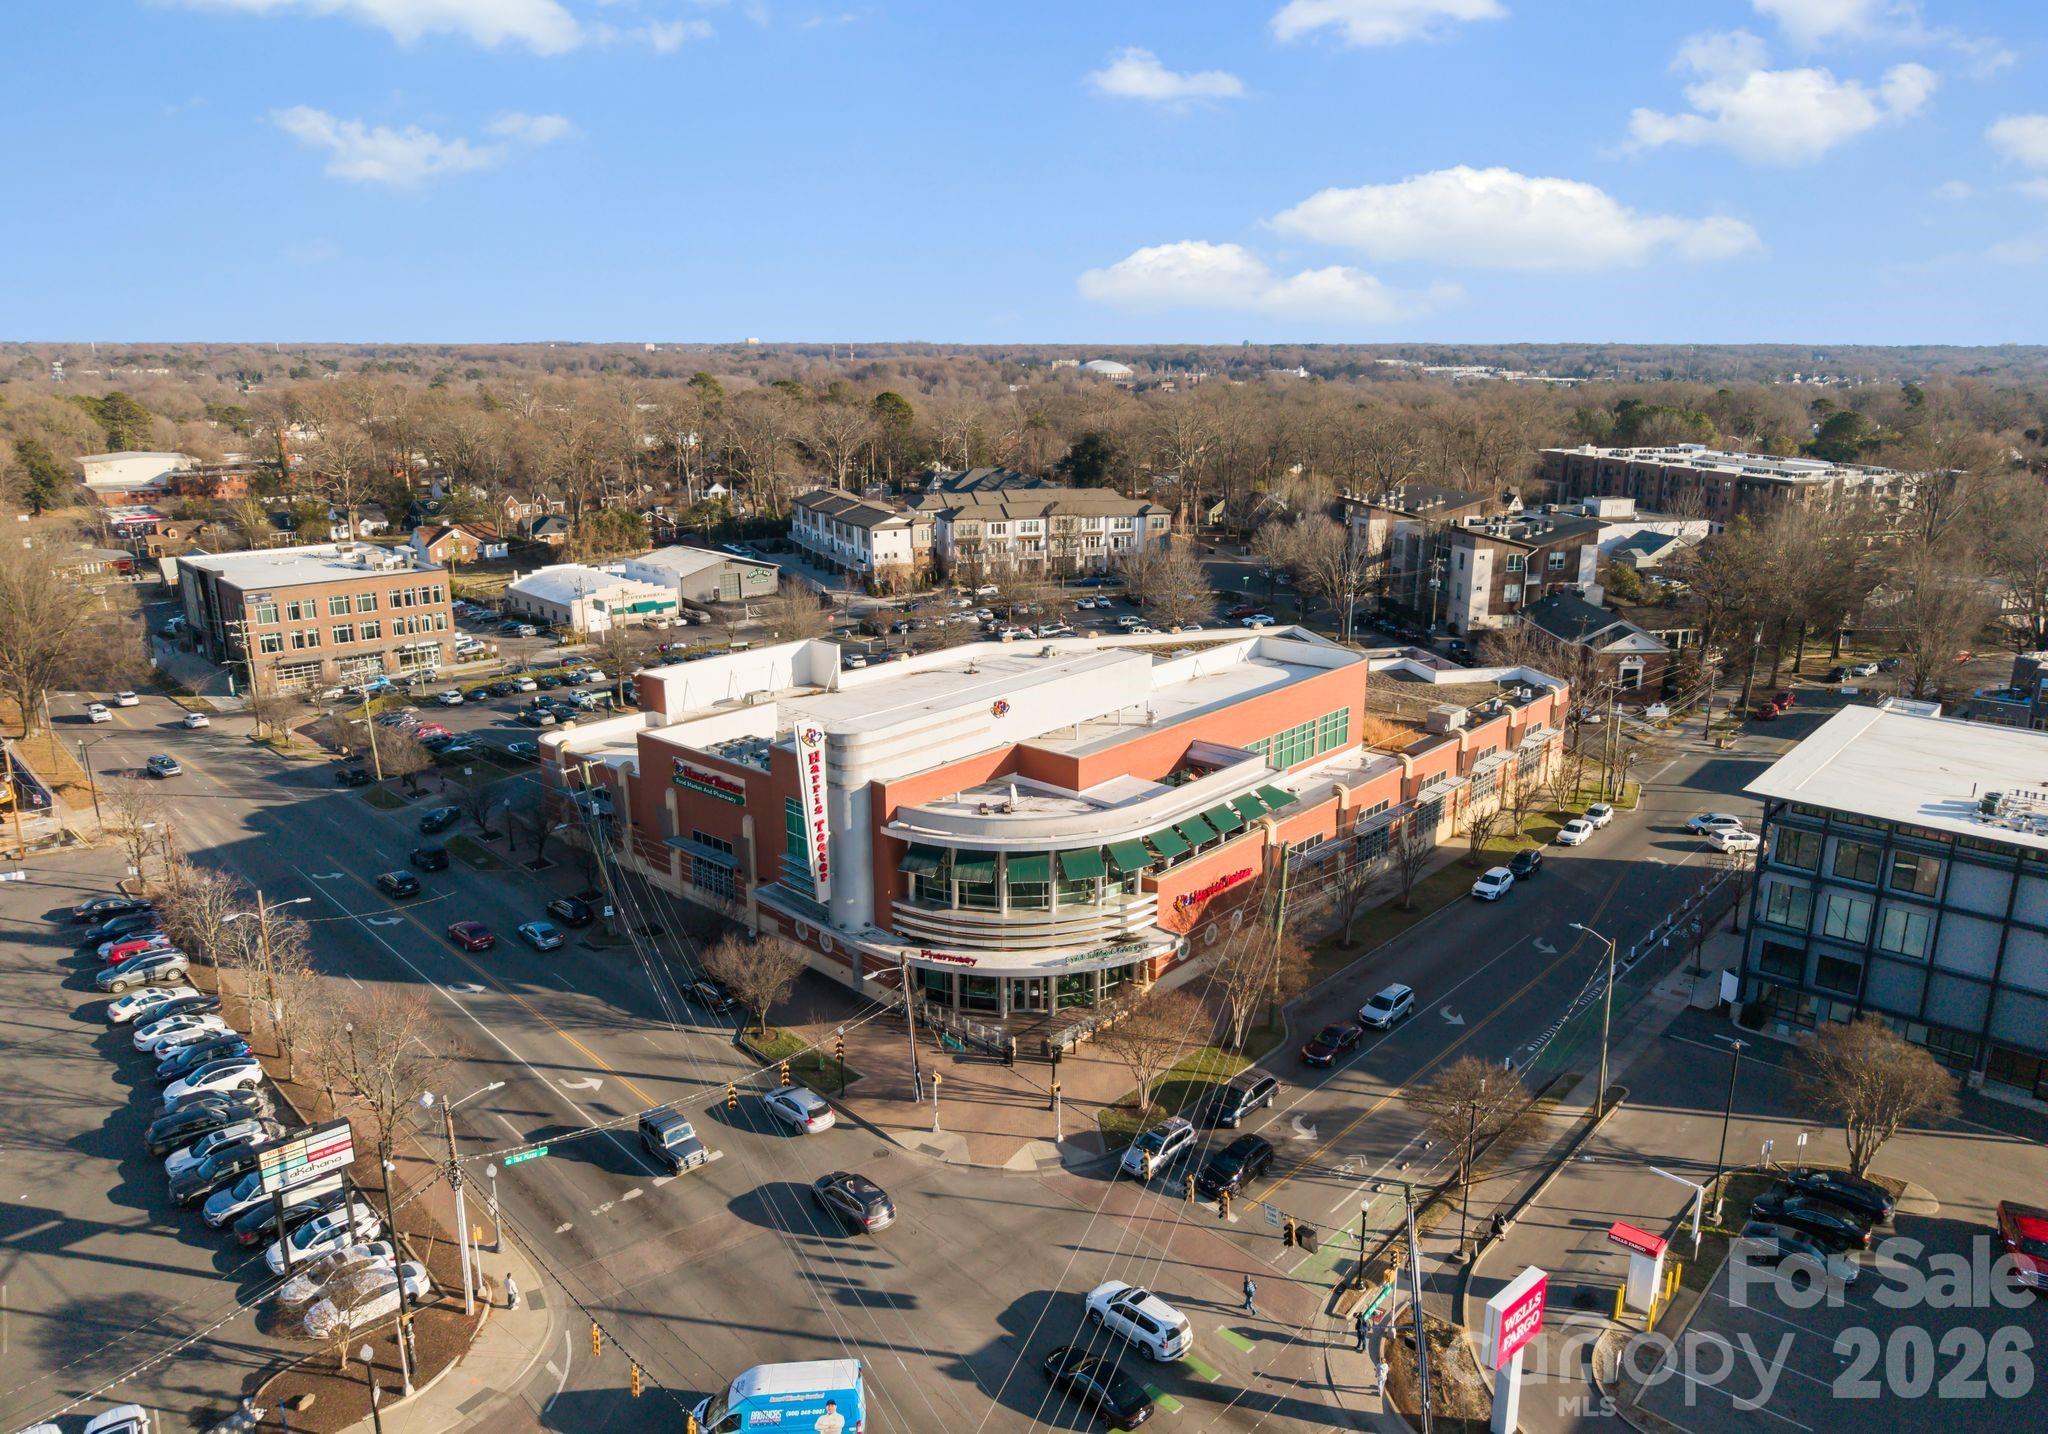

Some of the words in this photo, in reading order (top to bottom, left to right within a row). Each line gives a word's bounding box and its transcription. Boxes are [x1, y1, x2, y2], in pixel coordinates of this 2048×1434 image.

[675, 777, 687, 786] Food
[713, 790, 737, 804] Pharmacy
[808, 750, 823, 815] Harris
[814, 819, 828, 883] Teeter
[920, 949, 978, 967] Pharmacy
[1610, 1234, 1628, 1245] WELLS
[1628, 1241, 1647, 1252] FARGO
[1503, 1309, 1541, 1352] FARGO
[1504, 1291, 1543, 1333] WELLS
